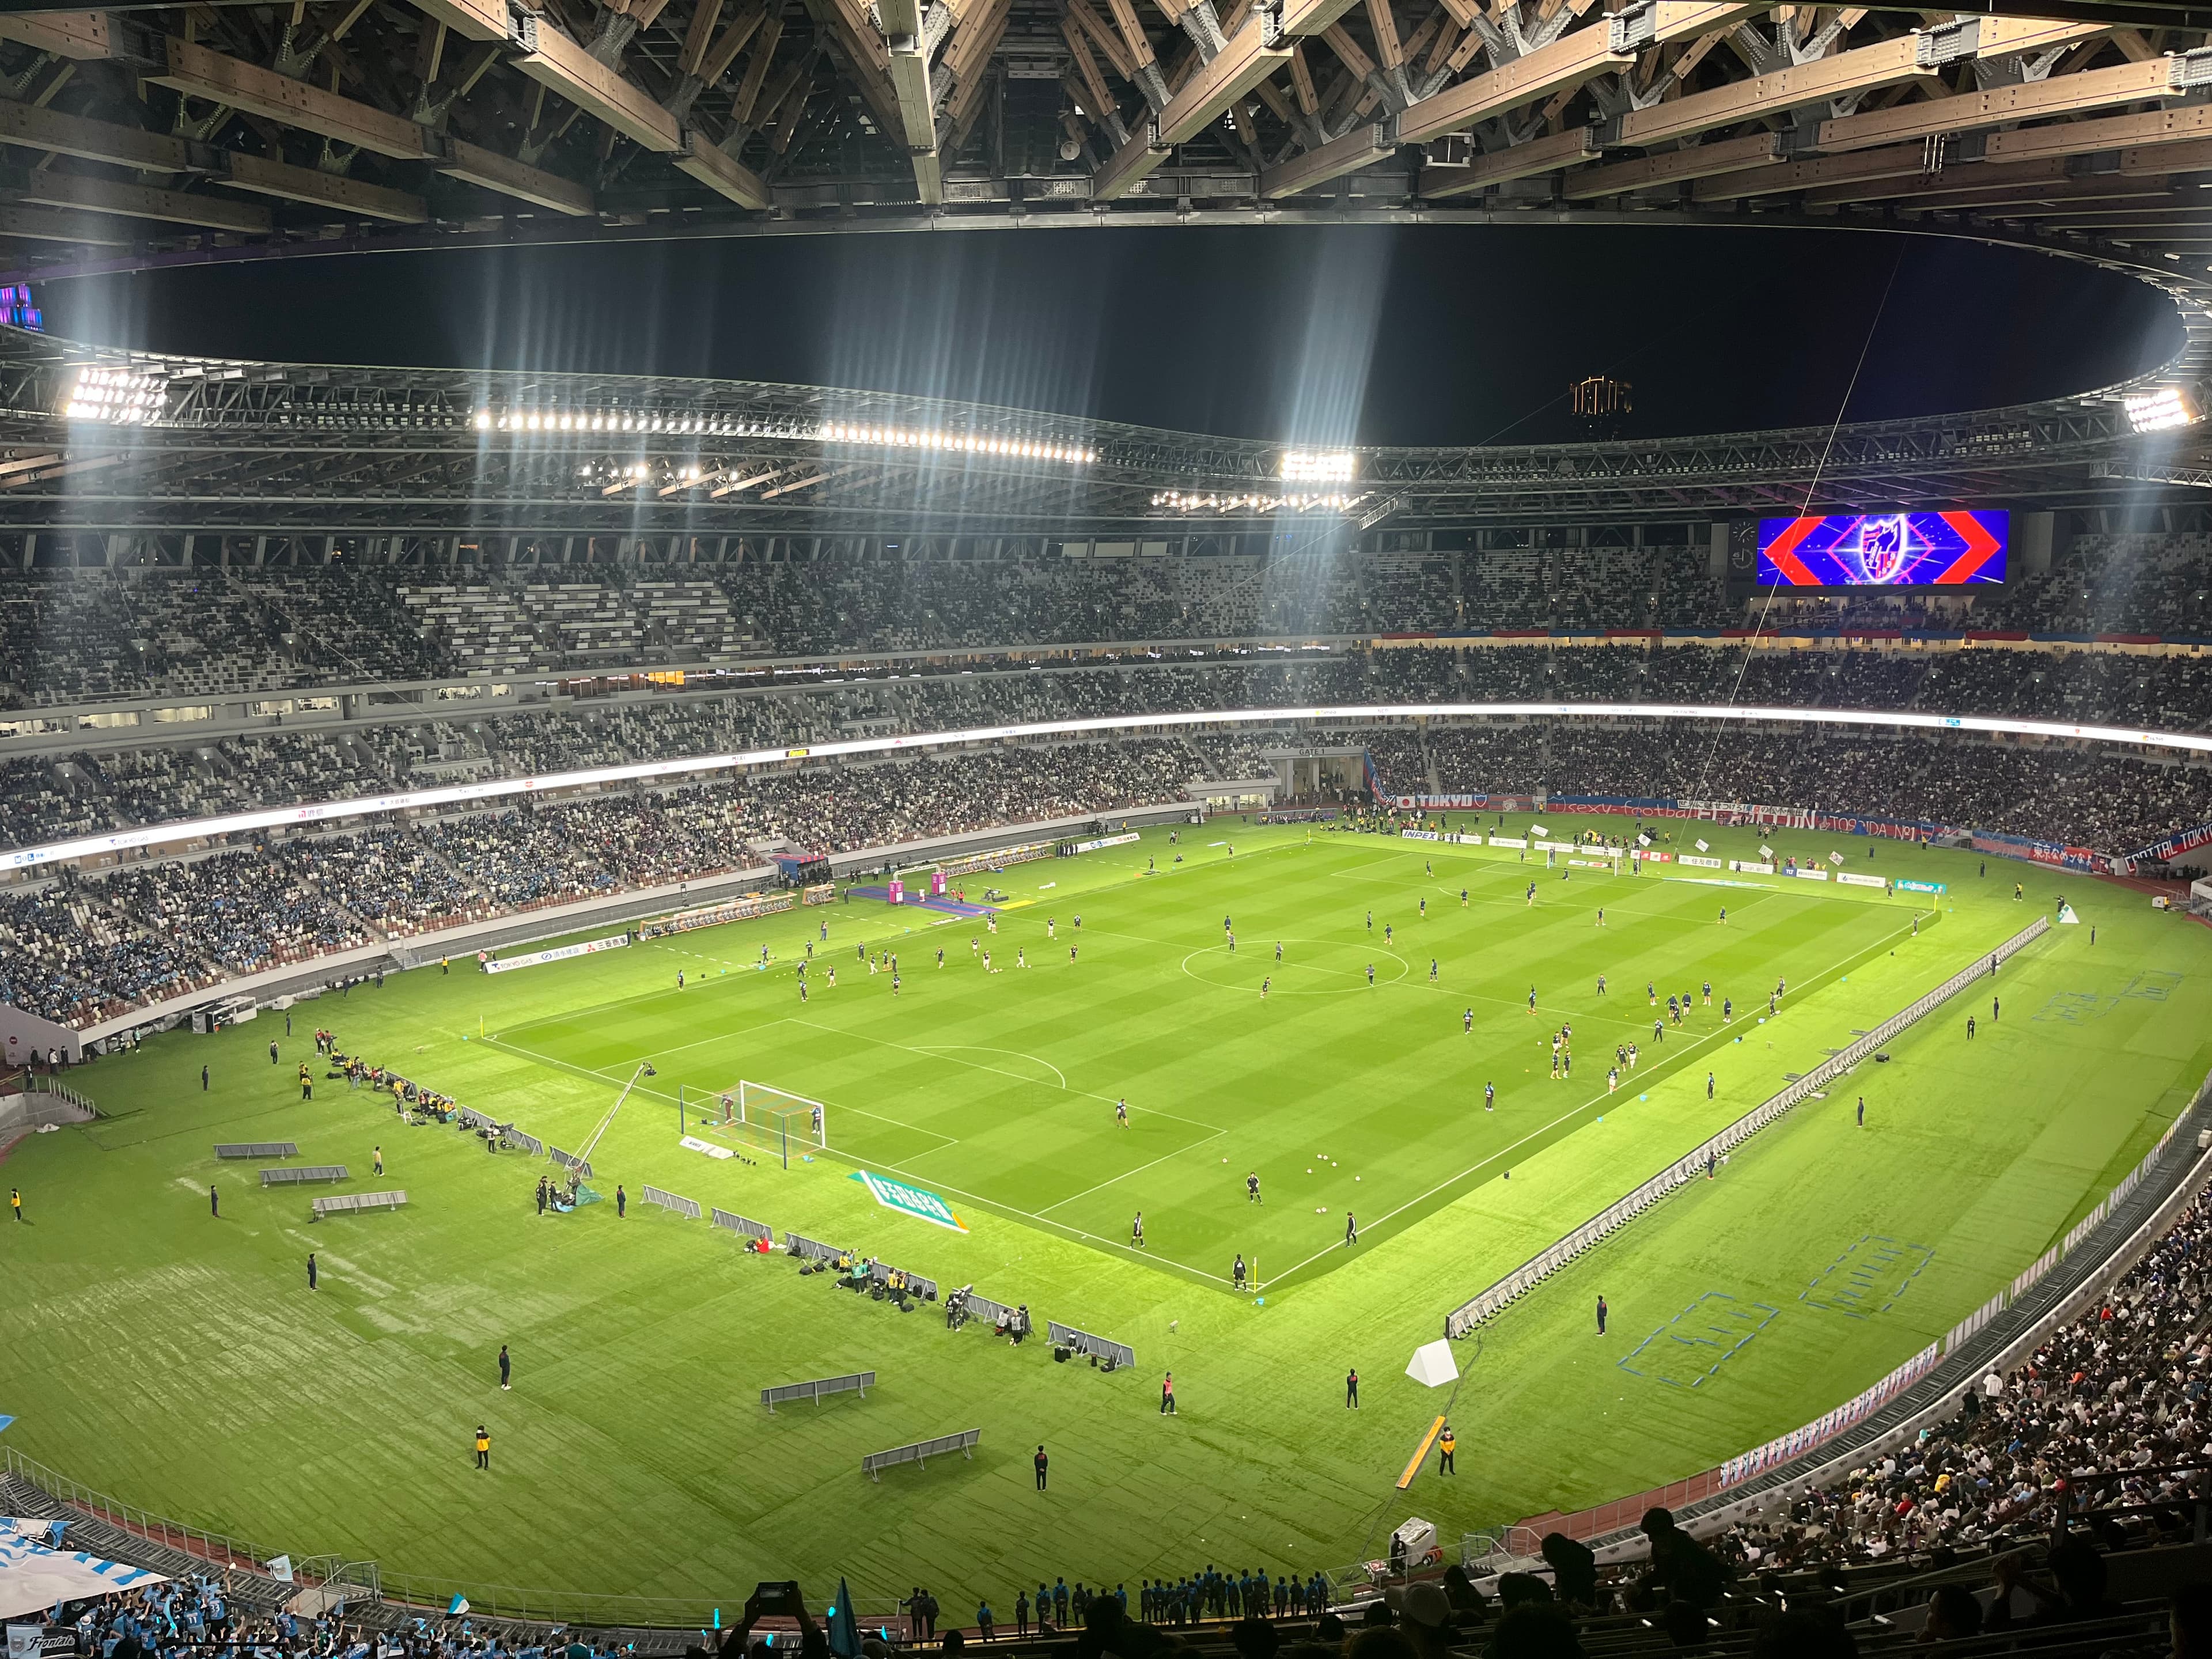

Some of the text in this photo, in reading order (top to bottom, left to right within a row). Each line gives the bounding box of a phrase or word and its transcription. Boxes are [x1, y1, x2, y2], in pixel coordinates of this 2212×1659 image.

[1417, 794, 1473, 807] TOKYO
[1404, 830, 1437, 840] INPEX
[1691, 857, 1719, 867] 住友商事
[597, 937, 627, 950] 三菱商事
[500, 958, 533, 969] TOKYO GAS
[26, 1634, 75, 1651] Frontale
